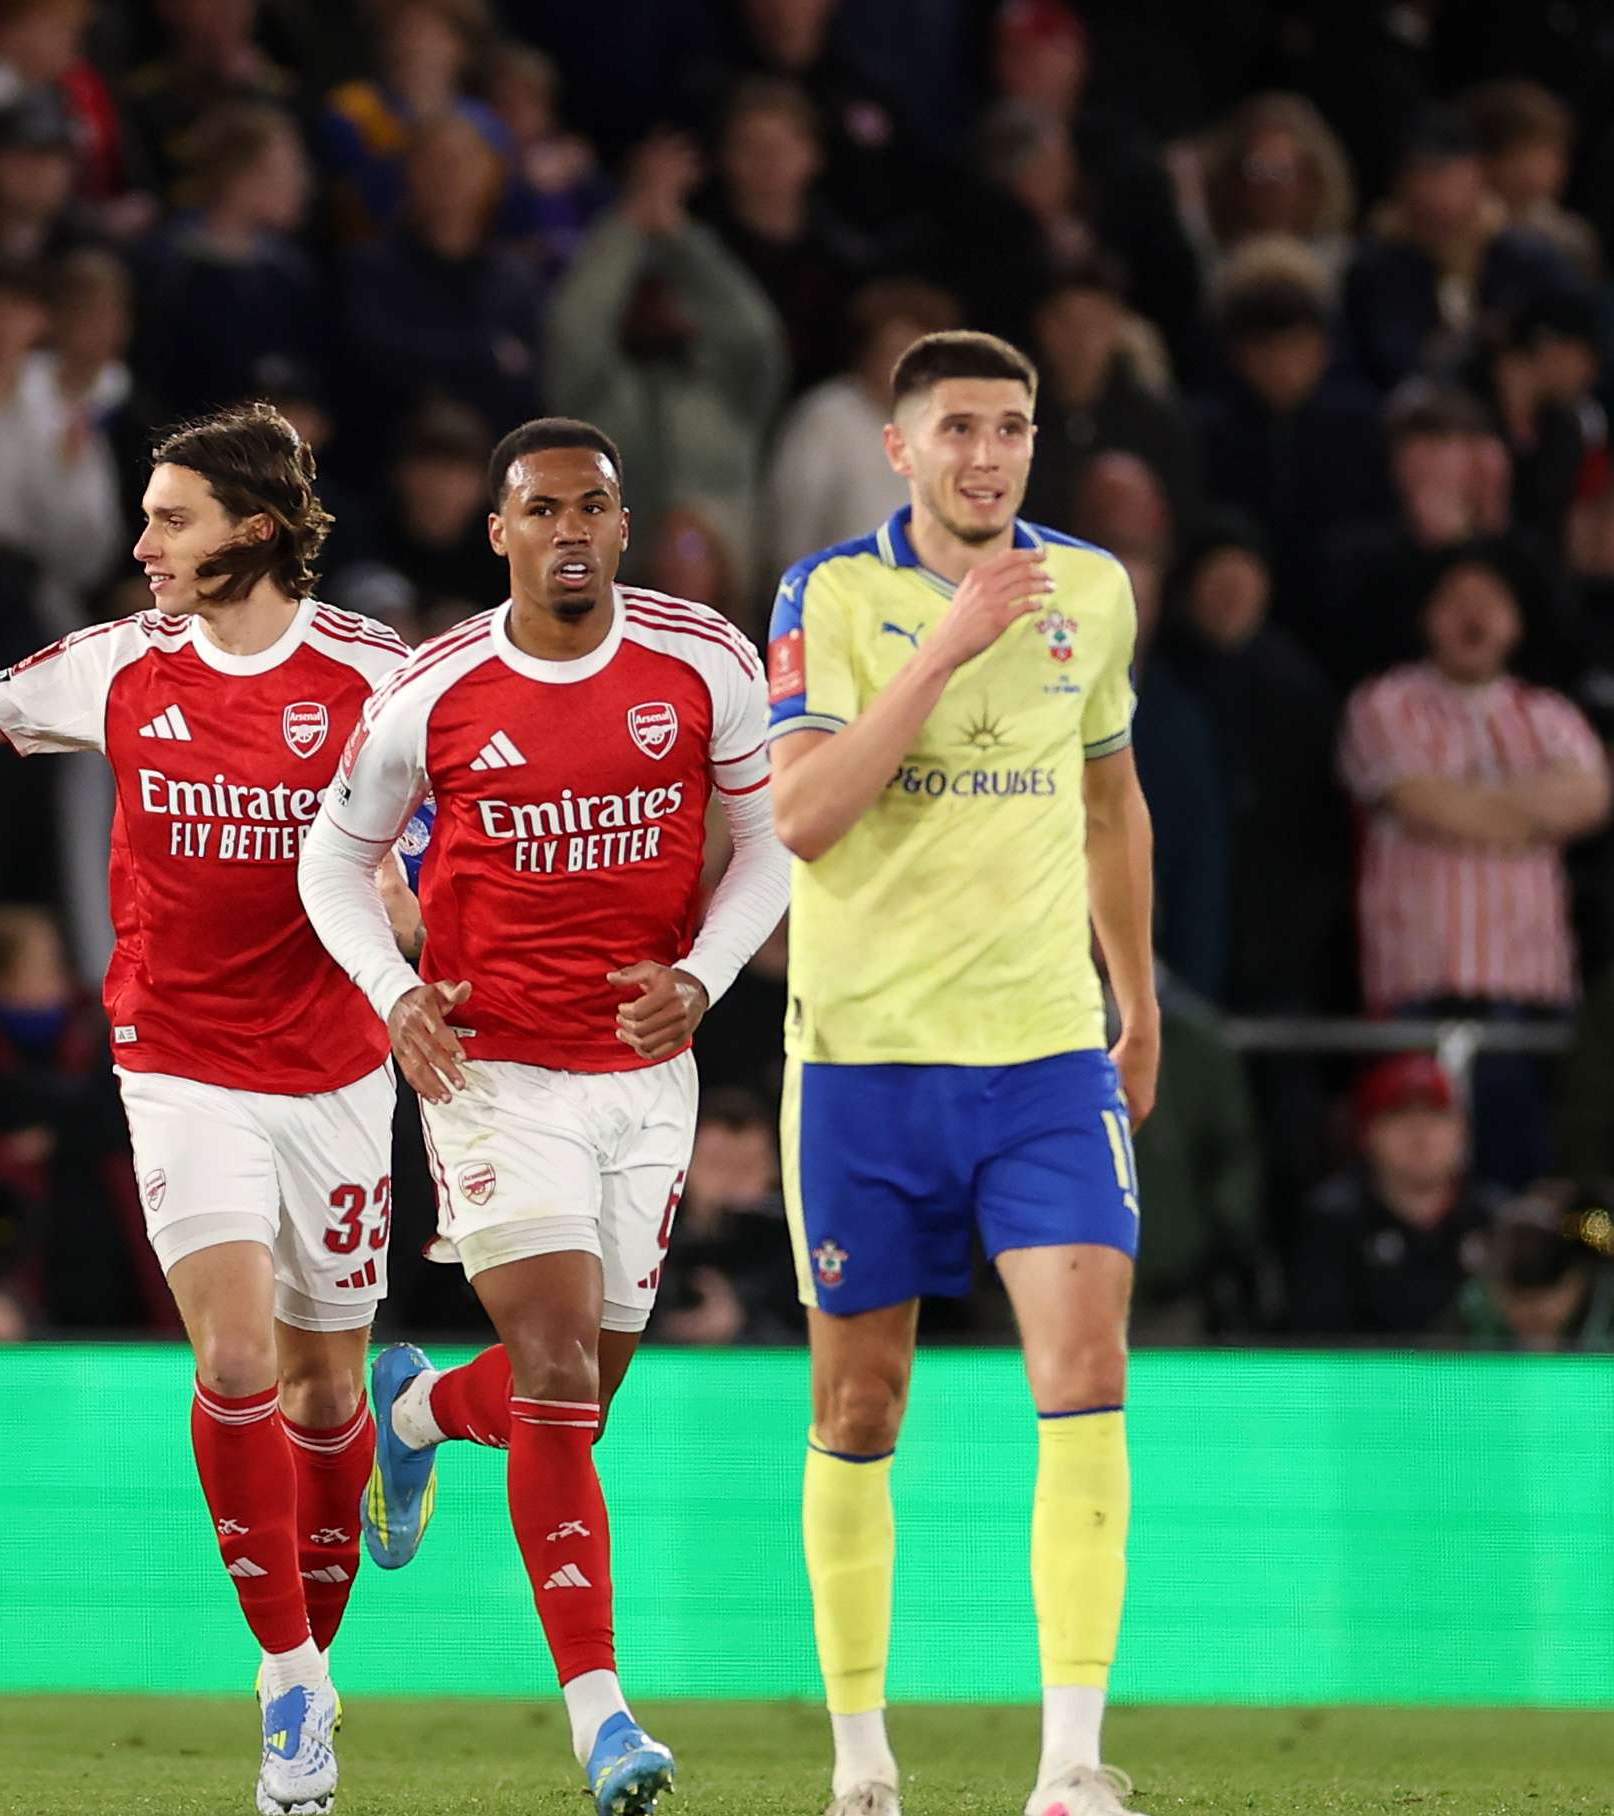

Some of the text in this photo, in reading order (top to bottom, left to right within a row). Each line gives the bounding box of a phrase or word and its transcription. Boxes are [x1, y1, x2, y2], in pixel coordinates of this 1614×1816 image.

[289, 711, 322, 721] Arsenal
[635, 711, 671, 724] Arsenal
[477, 781, 684, 838] Emirates
[170, 822, 212, 858] FLY
[515, 826, 661, 873] FLY BETTER
